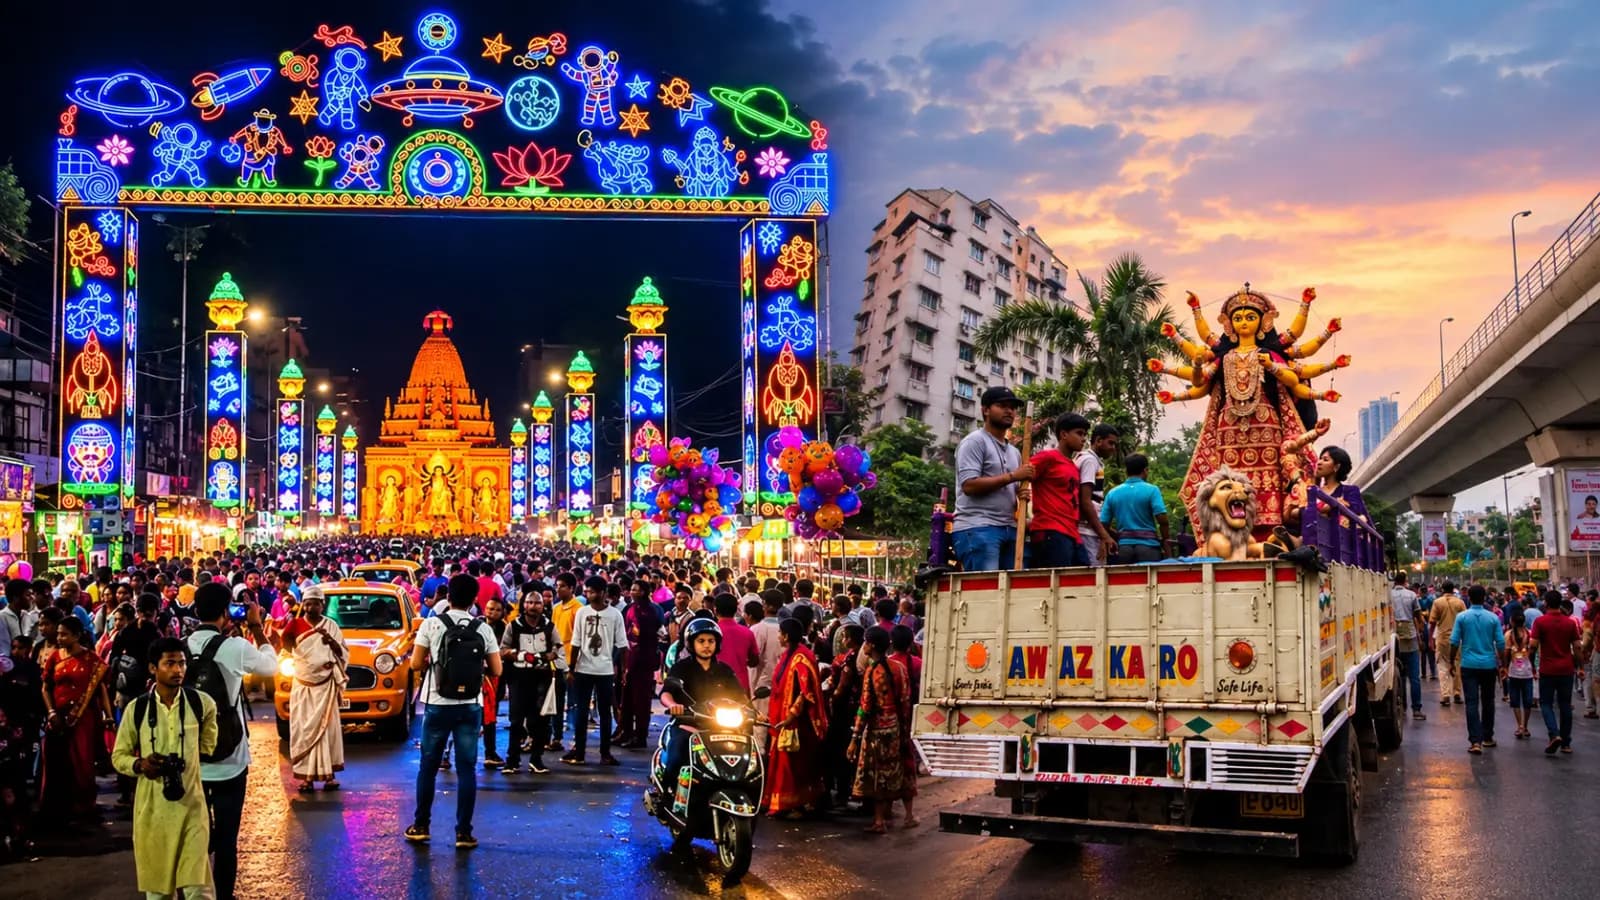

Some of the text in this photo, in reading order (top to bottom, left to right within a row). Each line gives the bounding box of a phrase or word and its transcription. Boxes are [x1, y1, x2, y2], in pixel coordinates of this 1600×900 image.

[1007, 645, 1048, 680] AW
[1058, 645, 1094, 680] AZ
[1110, 645, 1146, 680] KA
[1241, 680, 1264, 697] Life
